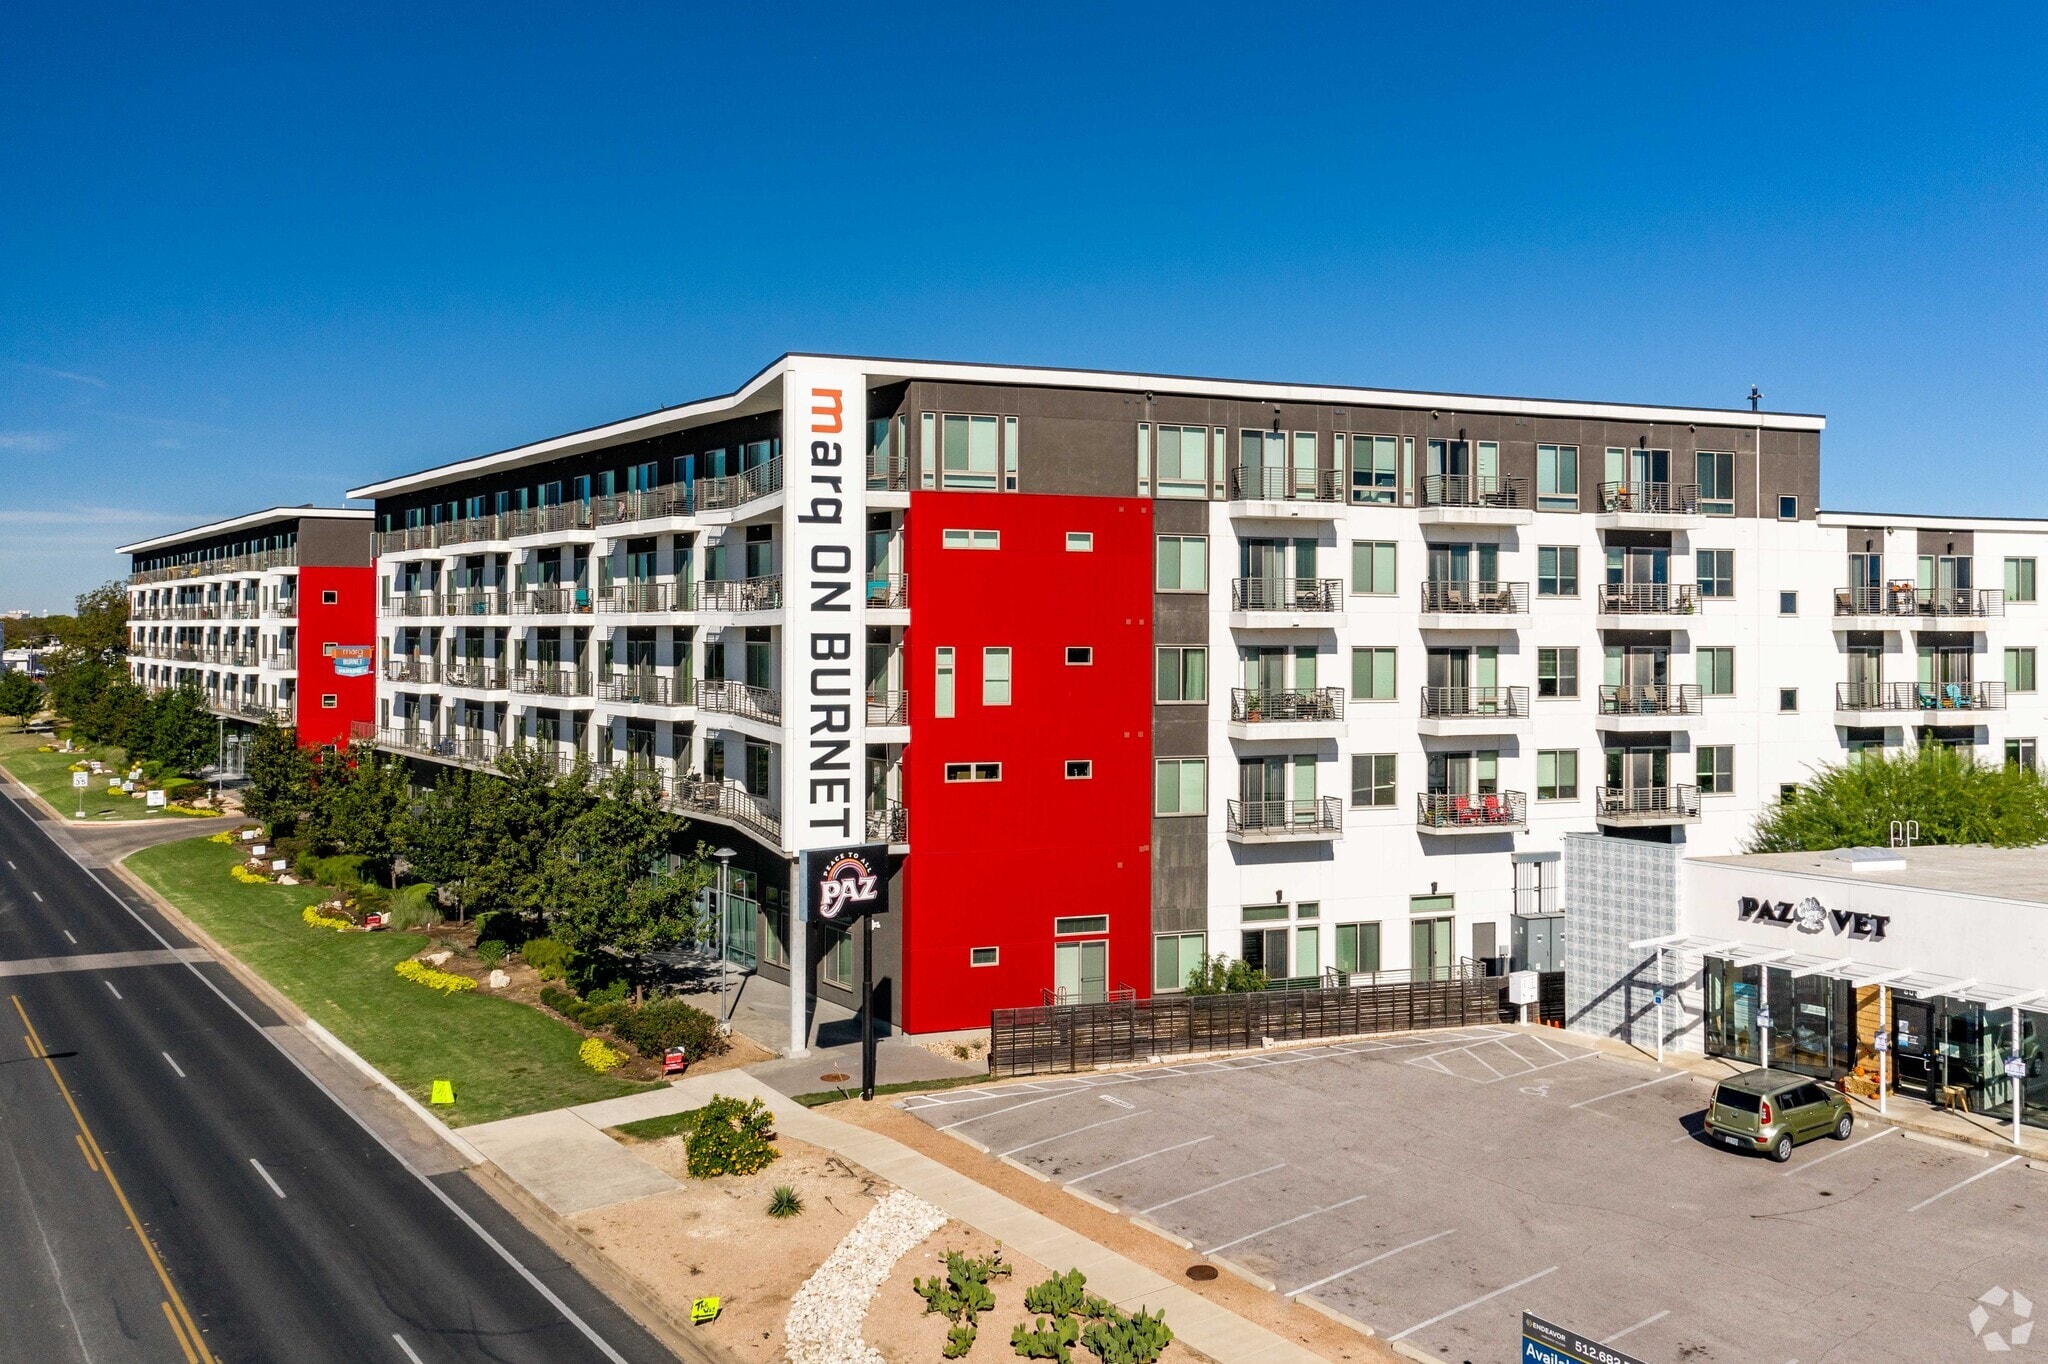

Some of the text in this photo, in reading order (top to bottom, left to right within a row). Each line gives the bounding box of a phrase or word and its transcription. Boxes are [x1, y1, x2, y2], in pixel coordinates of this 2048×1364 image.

[798, 388, 851, 838] marq ON BURNET
[823, 853, 845, 877] PEACE
[860, 858, 872, 873] ALL
[820, 875, 878, 918] PAZ
[1738, 896, 1891, 941] PAZ VET
[1532, 1322, 1566, 1342] ENDEAVOR
[1526, 1342, 1571, 1364] Avail
